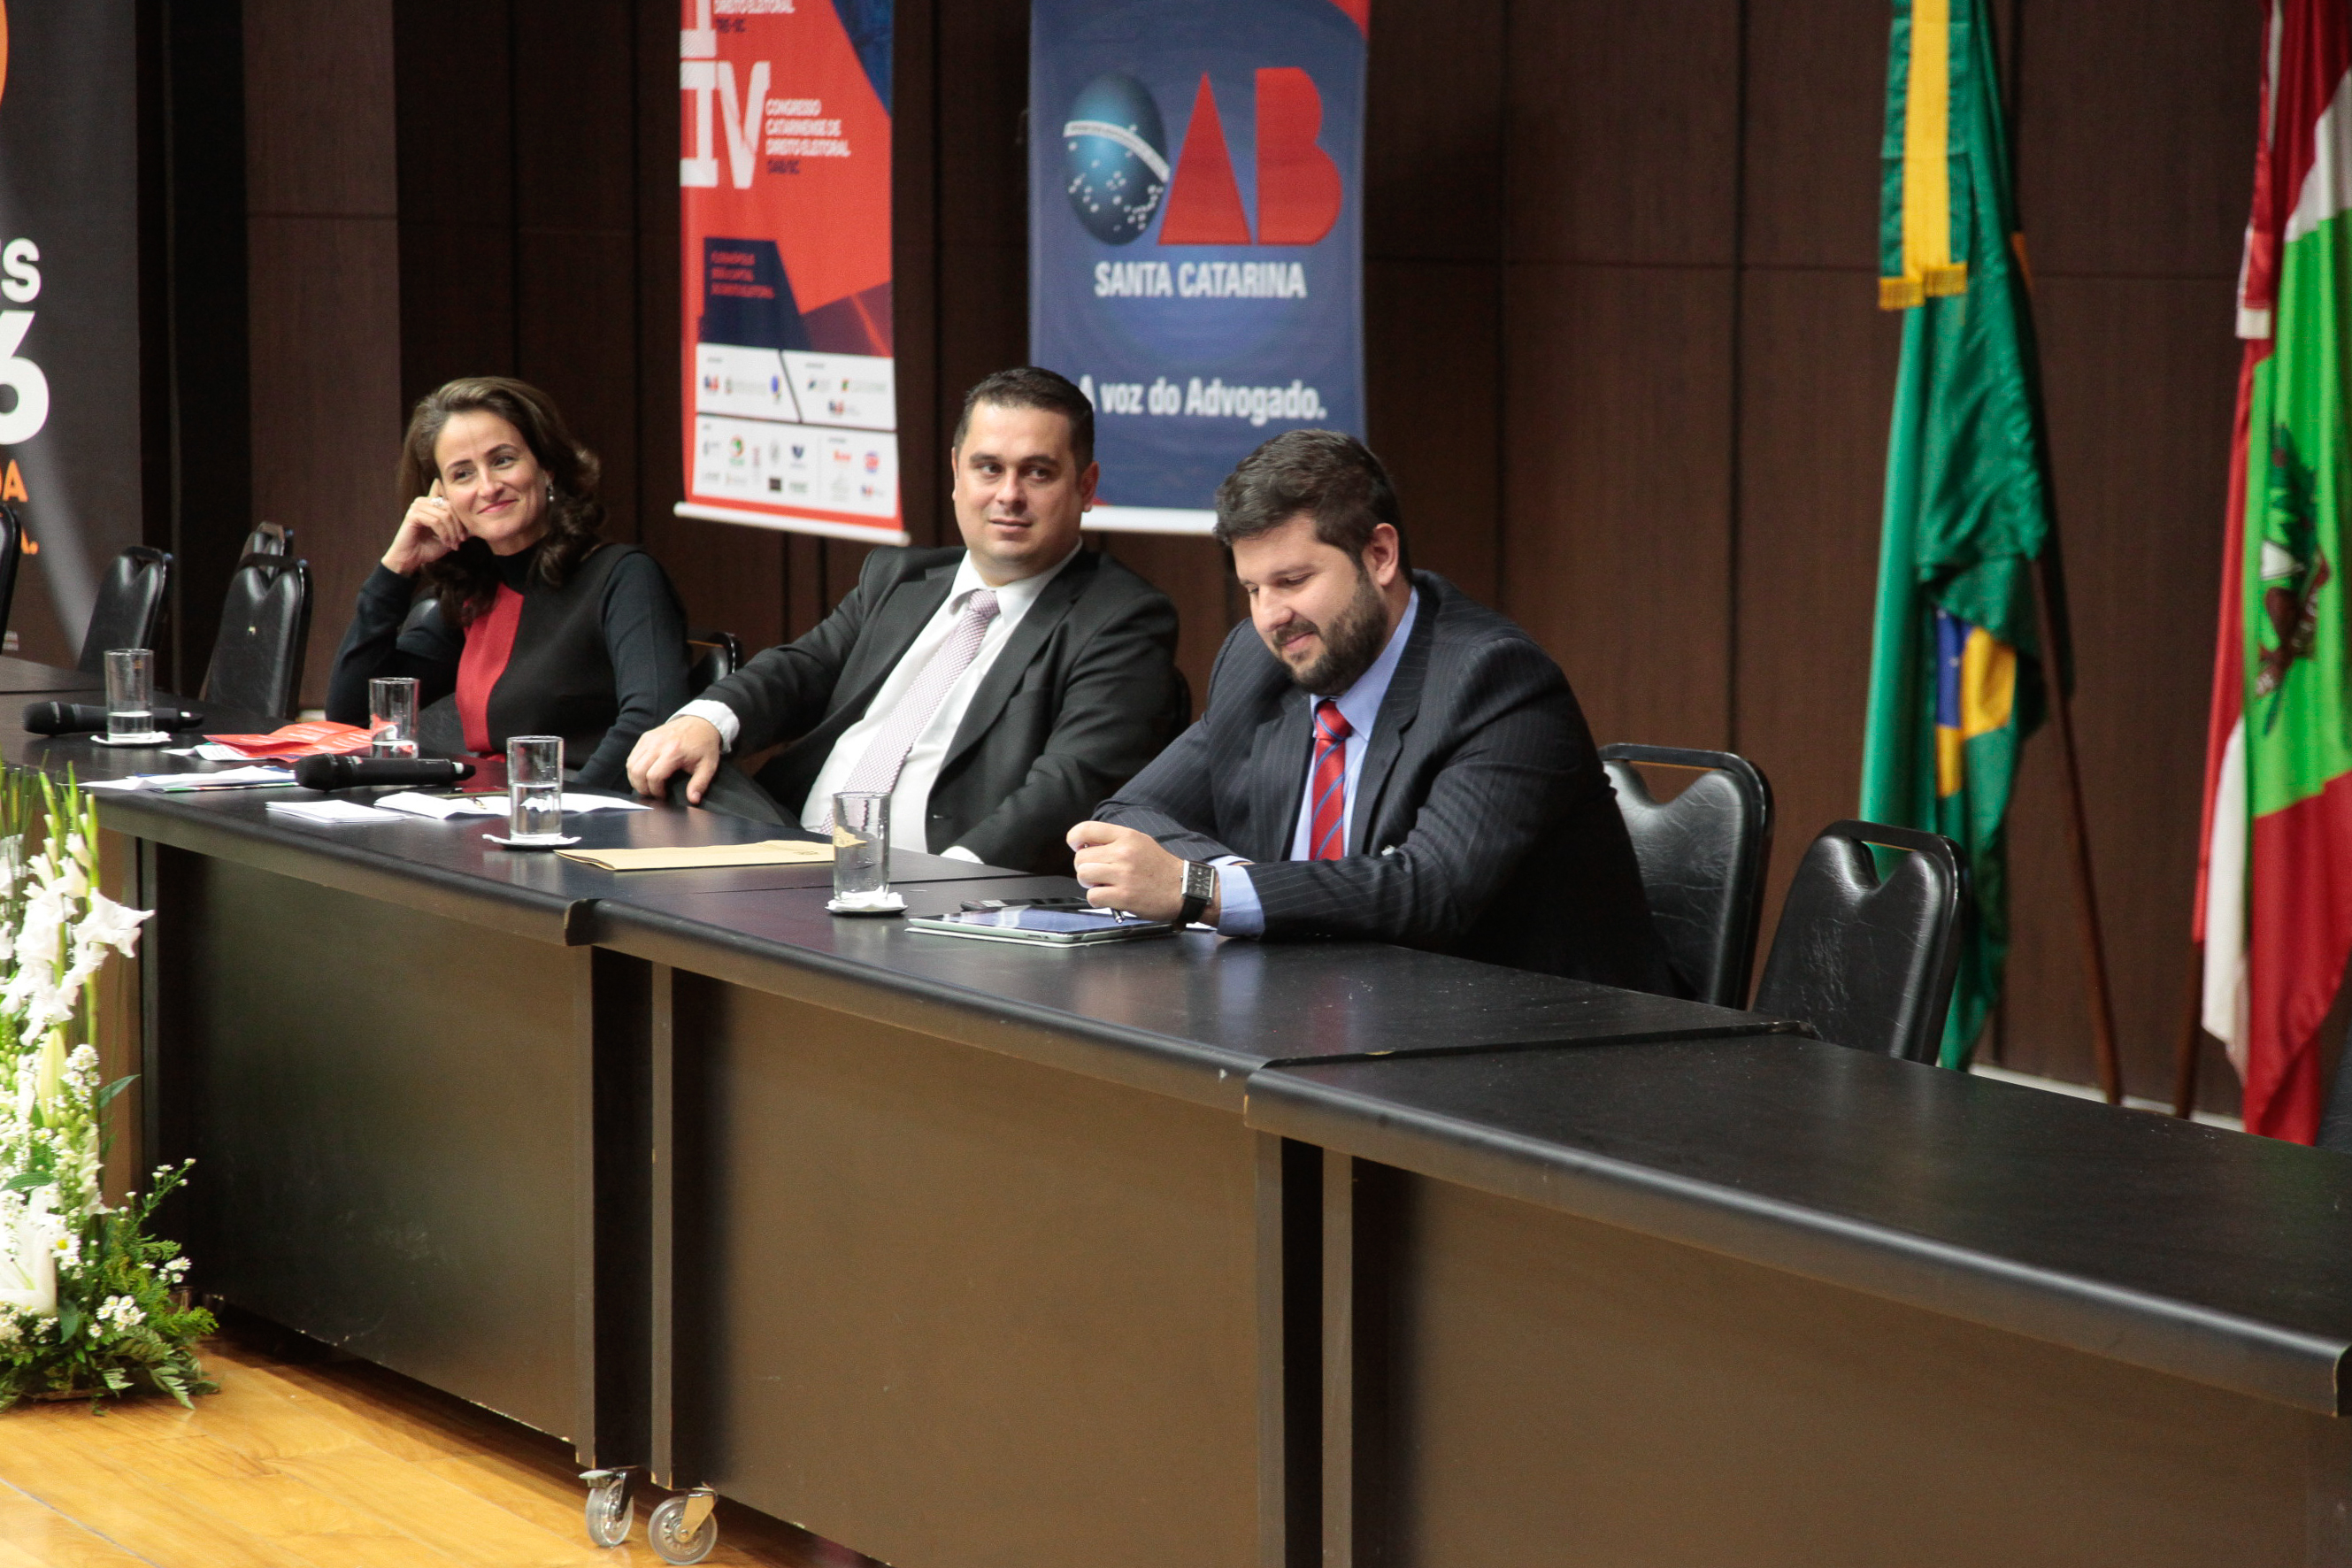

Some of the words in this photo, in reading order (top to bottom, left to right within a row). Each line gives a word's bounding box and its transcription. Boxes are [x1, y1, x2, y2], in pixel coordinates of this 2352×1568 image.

[680, 60, 771, 189] IV
[1094, 261, 1174, 297] SANTA
[1177, 262, 1308, 298] CATARINA
[1099, 382, 1144, 415] voz
[1148, 376, 1182, 415] do
[1184, 376, 1327, 427] Advogado.
[0, 458, 29, 503] A
